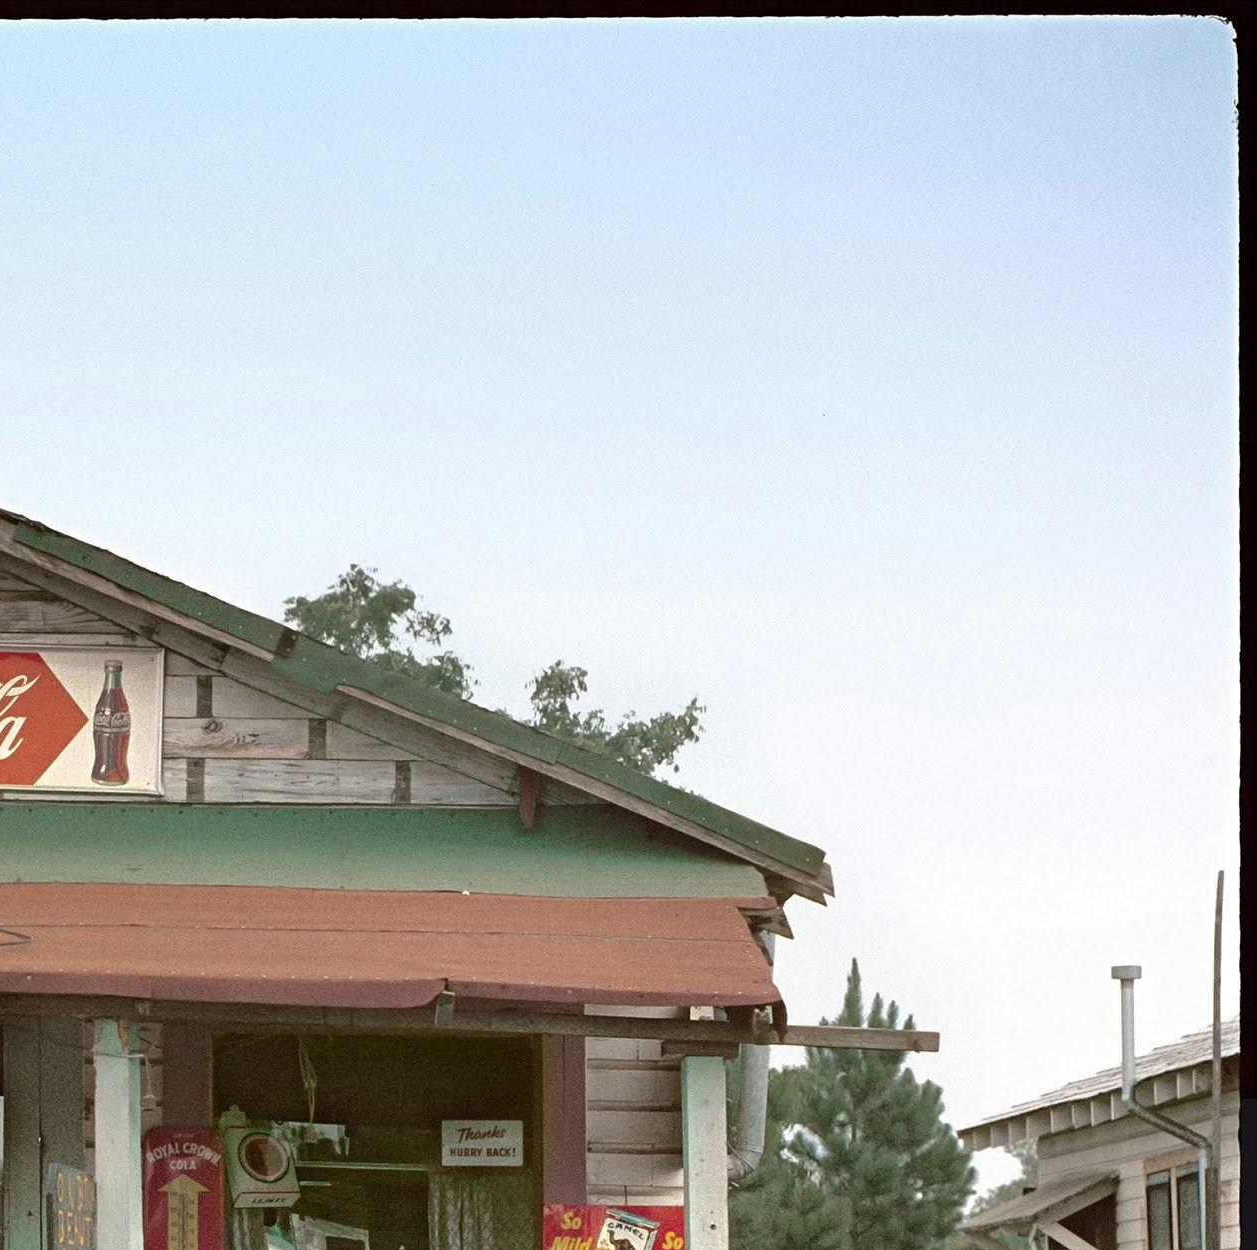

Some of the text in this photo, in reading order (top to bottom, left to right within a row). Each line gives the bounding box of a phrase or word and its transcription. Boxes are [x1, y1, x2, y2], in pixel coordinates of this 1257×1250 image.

[456, 1125, 507, 1144] Thanks
[145, 1141, 222, 1165] ROYAL CROWN
[449, 1147, 516, 1158] HURRY BACK!
[169, 1160, 197, 1170] COLA
[560, 1211, 582, 1230] So
[607, 1222, 645, 1241] CAMEL
[662, 1231, 684, 1250] So
